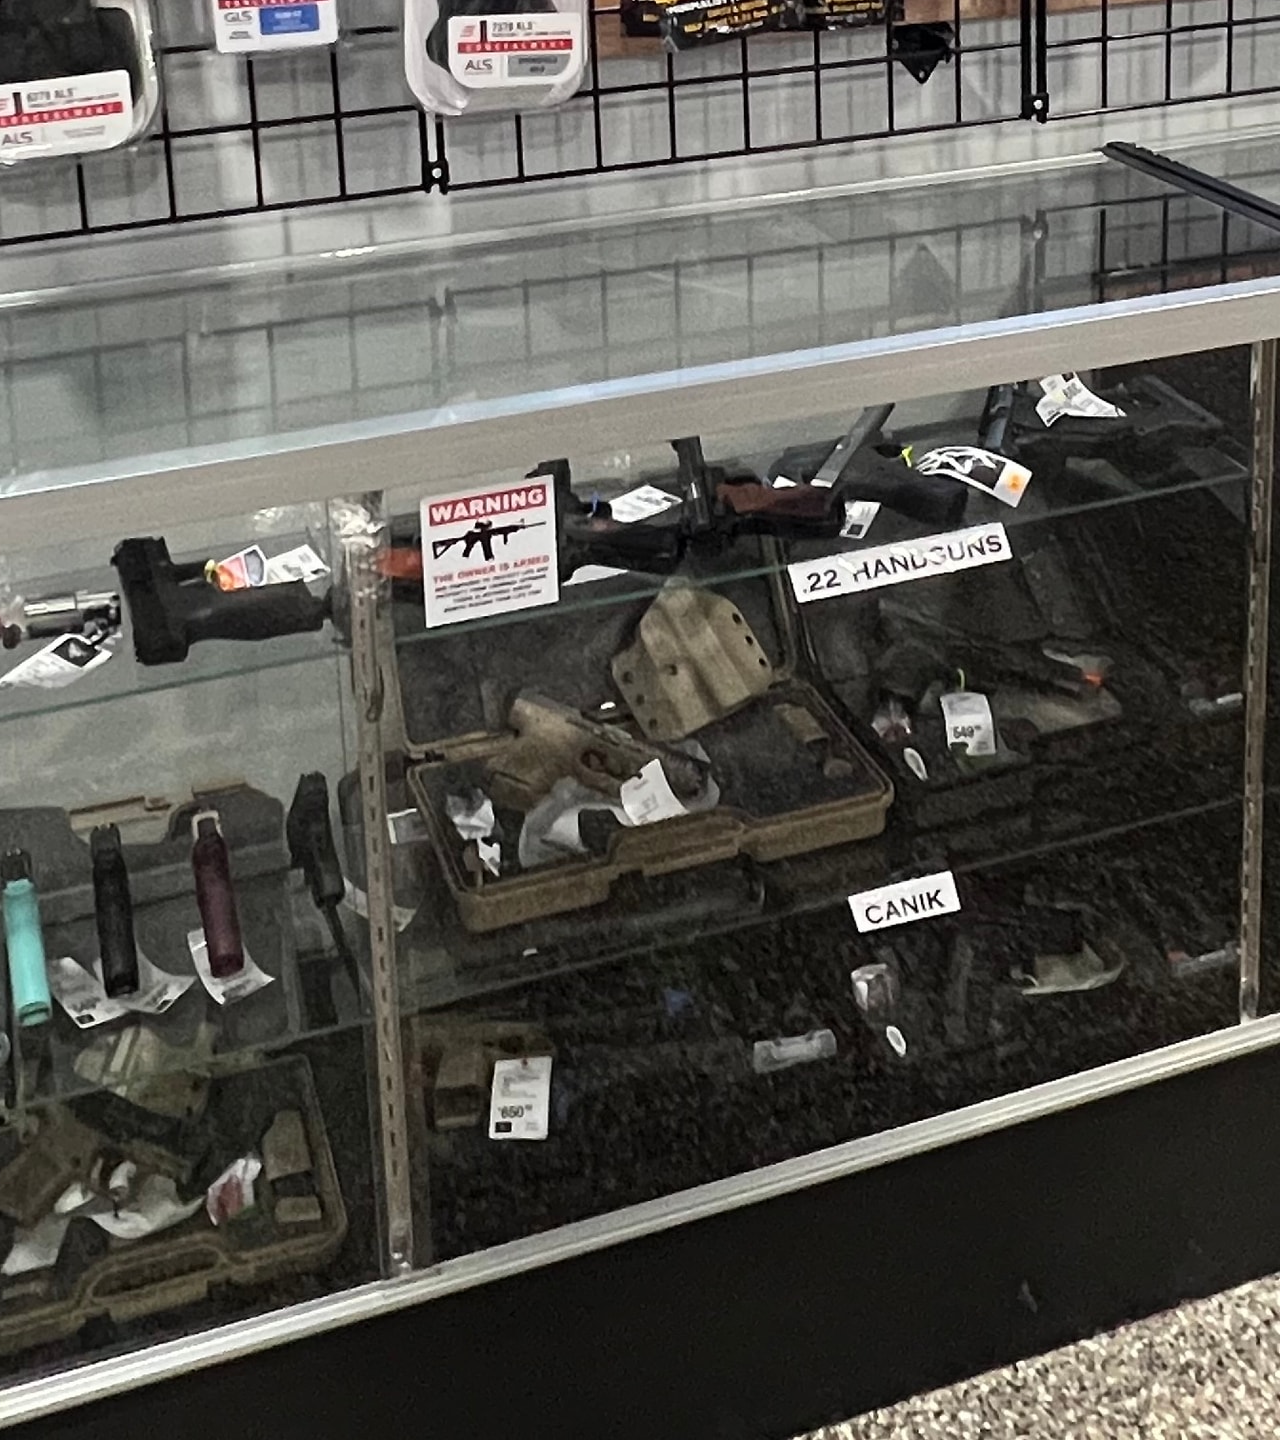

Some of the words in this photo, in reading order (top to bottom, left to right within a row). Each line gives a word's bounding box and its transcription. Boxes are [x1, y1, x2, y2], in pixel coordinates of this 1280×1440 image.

[223, 11, 253, 23] GLS
[465, 58, 493, 71] ALS
[1, 131, 34, 146] ALS
[431, 487, 545, 523] WARNING
[801, 567, 843, 596] .22
[852, 534, 1004, 585] HANDGUNS
[865, 888, 947, 926] CANIK
